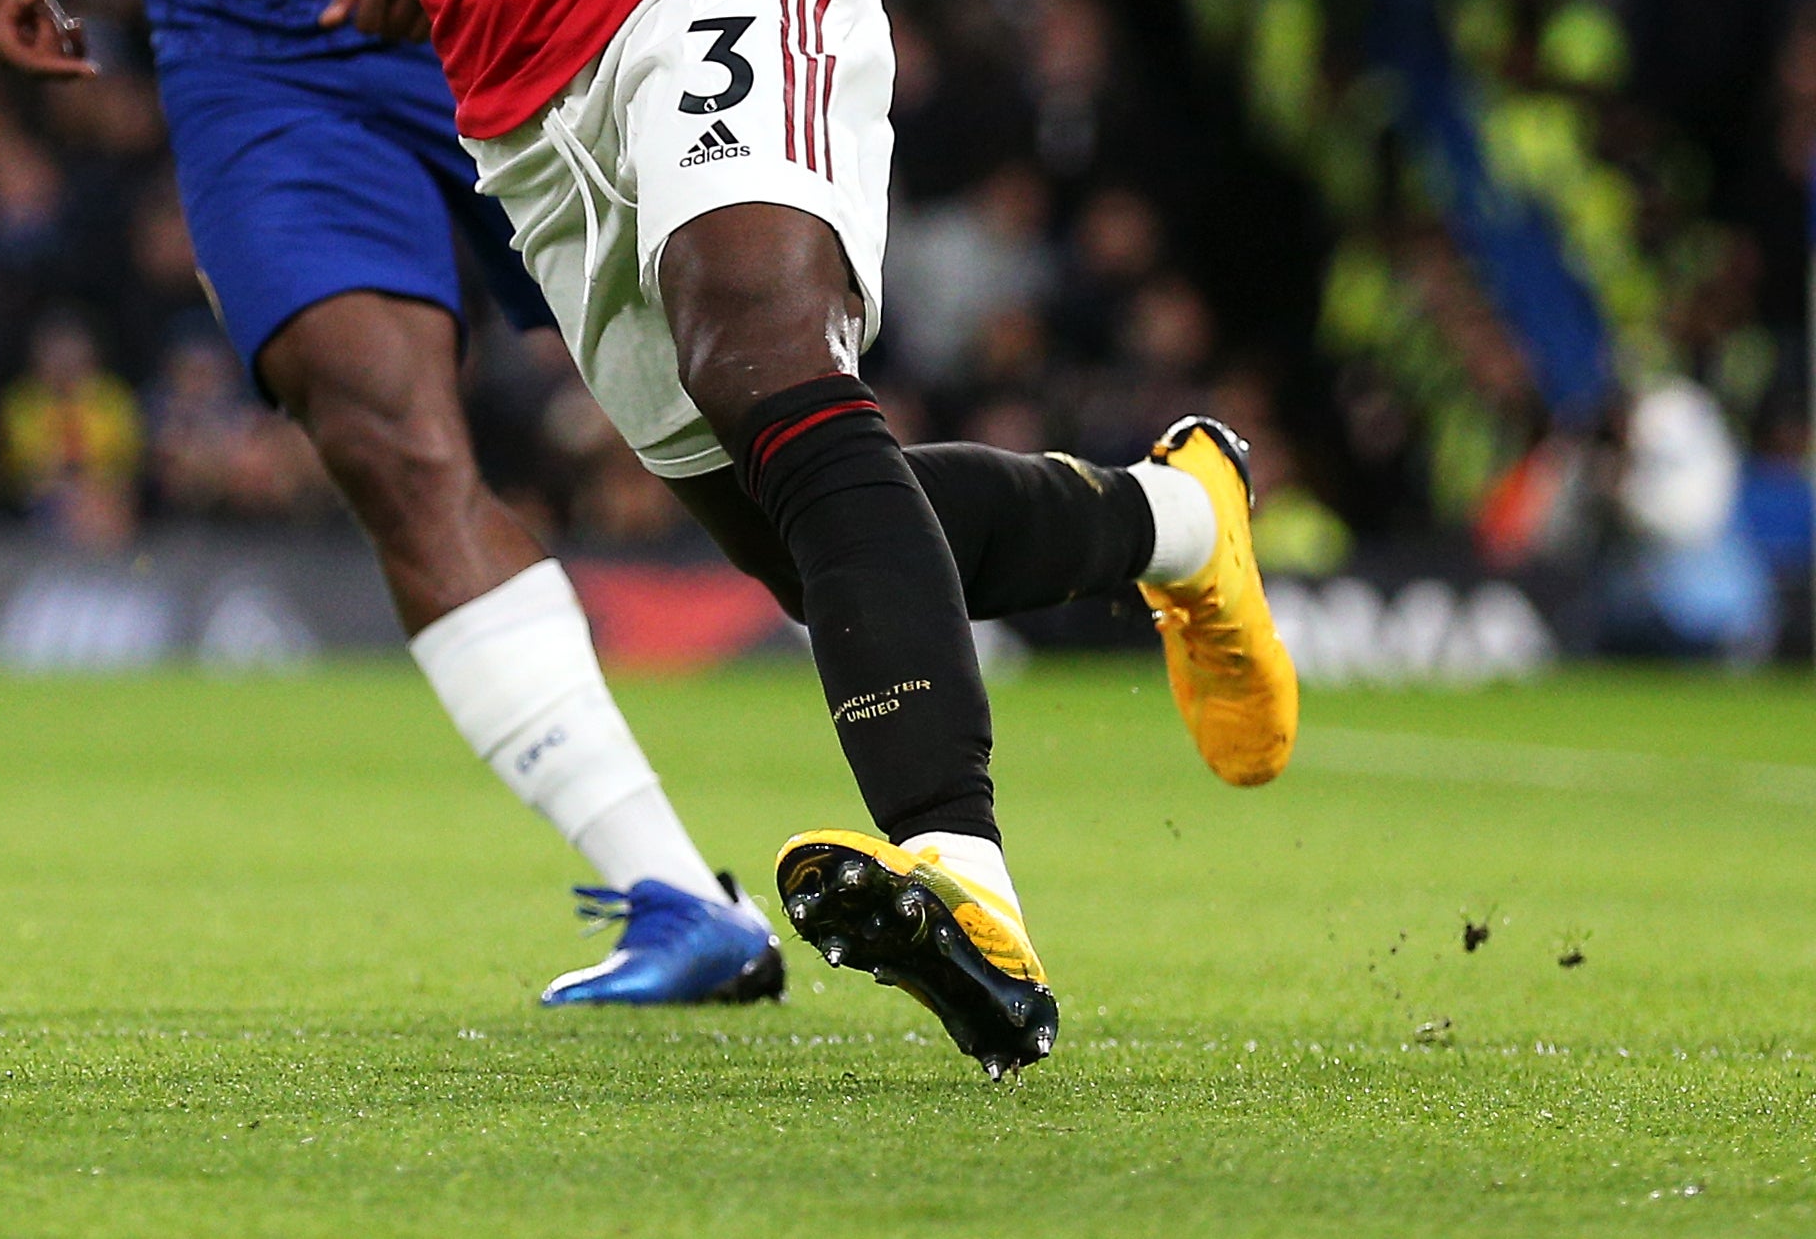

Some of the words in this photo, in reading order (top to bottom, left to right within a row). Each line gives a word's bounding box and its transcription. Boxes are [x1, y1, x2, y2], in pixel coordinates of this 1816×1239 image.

[678, 16, 757, 115] 3
[680, 145, 751, 168] adidas
[846, 699, 900, 722] UNITED
